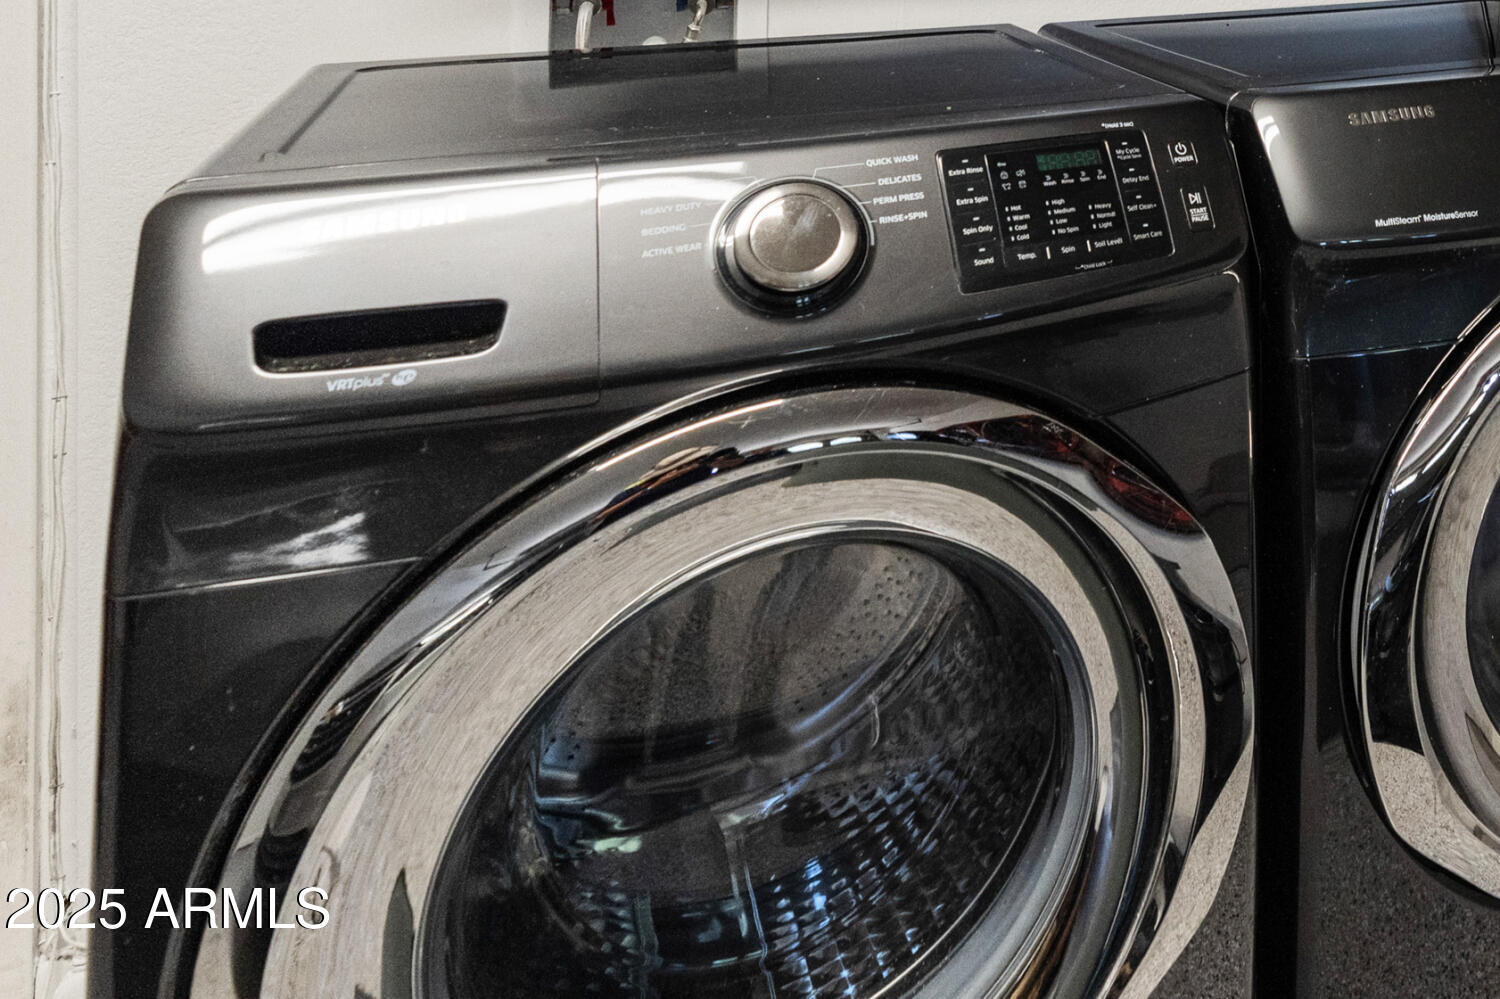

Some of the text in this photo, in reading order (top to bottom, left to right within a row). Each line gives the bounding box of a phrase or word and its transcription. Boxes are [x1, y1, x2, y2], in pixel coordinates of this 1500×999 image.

[1348, 104, 1436, 127] SAMSUNG
[1115, 147, 1140, 156] My Cycle
[866, 154, 919, 168] QUICK WASH
[1173, 155, 1194, 163] POWER
[948, 166, 984, 177] Extra Rinse
[877, 173, 922, 186] DELICATES
[1122, 176, 1138, 184] Delay
[872, 191, 925, 206] PERM PRESS
[956, 195, 988, 206] Extra Spin
[1051, 198, 1065, 206] High
[640, 201, 702, 217] HEAVY DUTY
[1053, 206, 1076, 215] Medium
[1094, 202, 1112, 210] Heavy
[1127, 204, 1138, 212] Self
[1189, 206, 1208, 214] START
[878, 210, 928, 224] RINSE+SPIN
[1012, 213, 1031, 221] Warm
[1096, 211, 1116, 219] Normal
[1191, 214, 1210, 223] PAUSE
[1375, 210, 1479, 228] MultiSteam MoistureSensor
[1014, 223, 1028, 231] Cool
[1098, 221, 1112, 229] Light
[640, 223, 686, 237] BEDDING
[962, 224, 993, 236] Spin Only
[1016, 233, 1030, 241] Cold
[1133, 230, 1163, 240] Smart Care
[1094, 237, 1124, 249] Soil Level
[641, 242, 702, 258] ACTIVE WEAR
[1061, 245, 1076, 254] Spin
[973, 256, 995, 267] Sound
